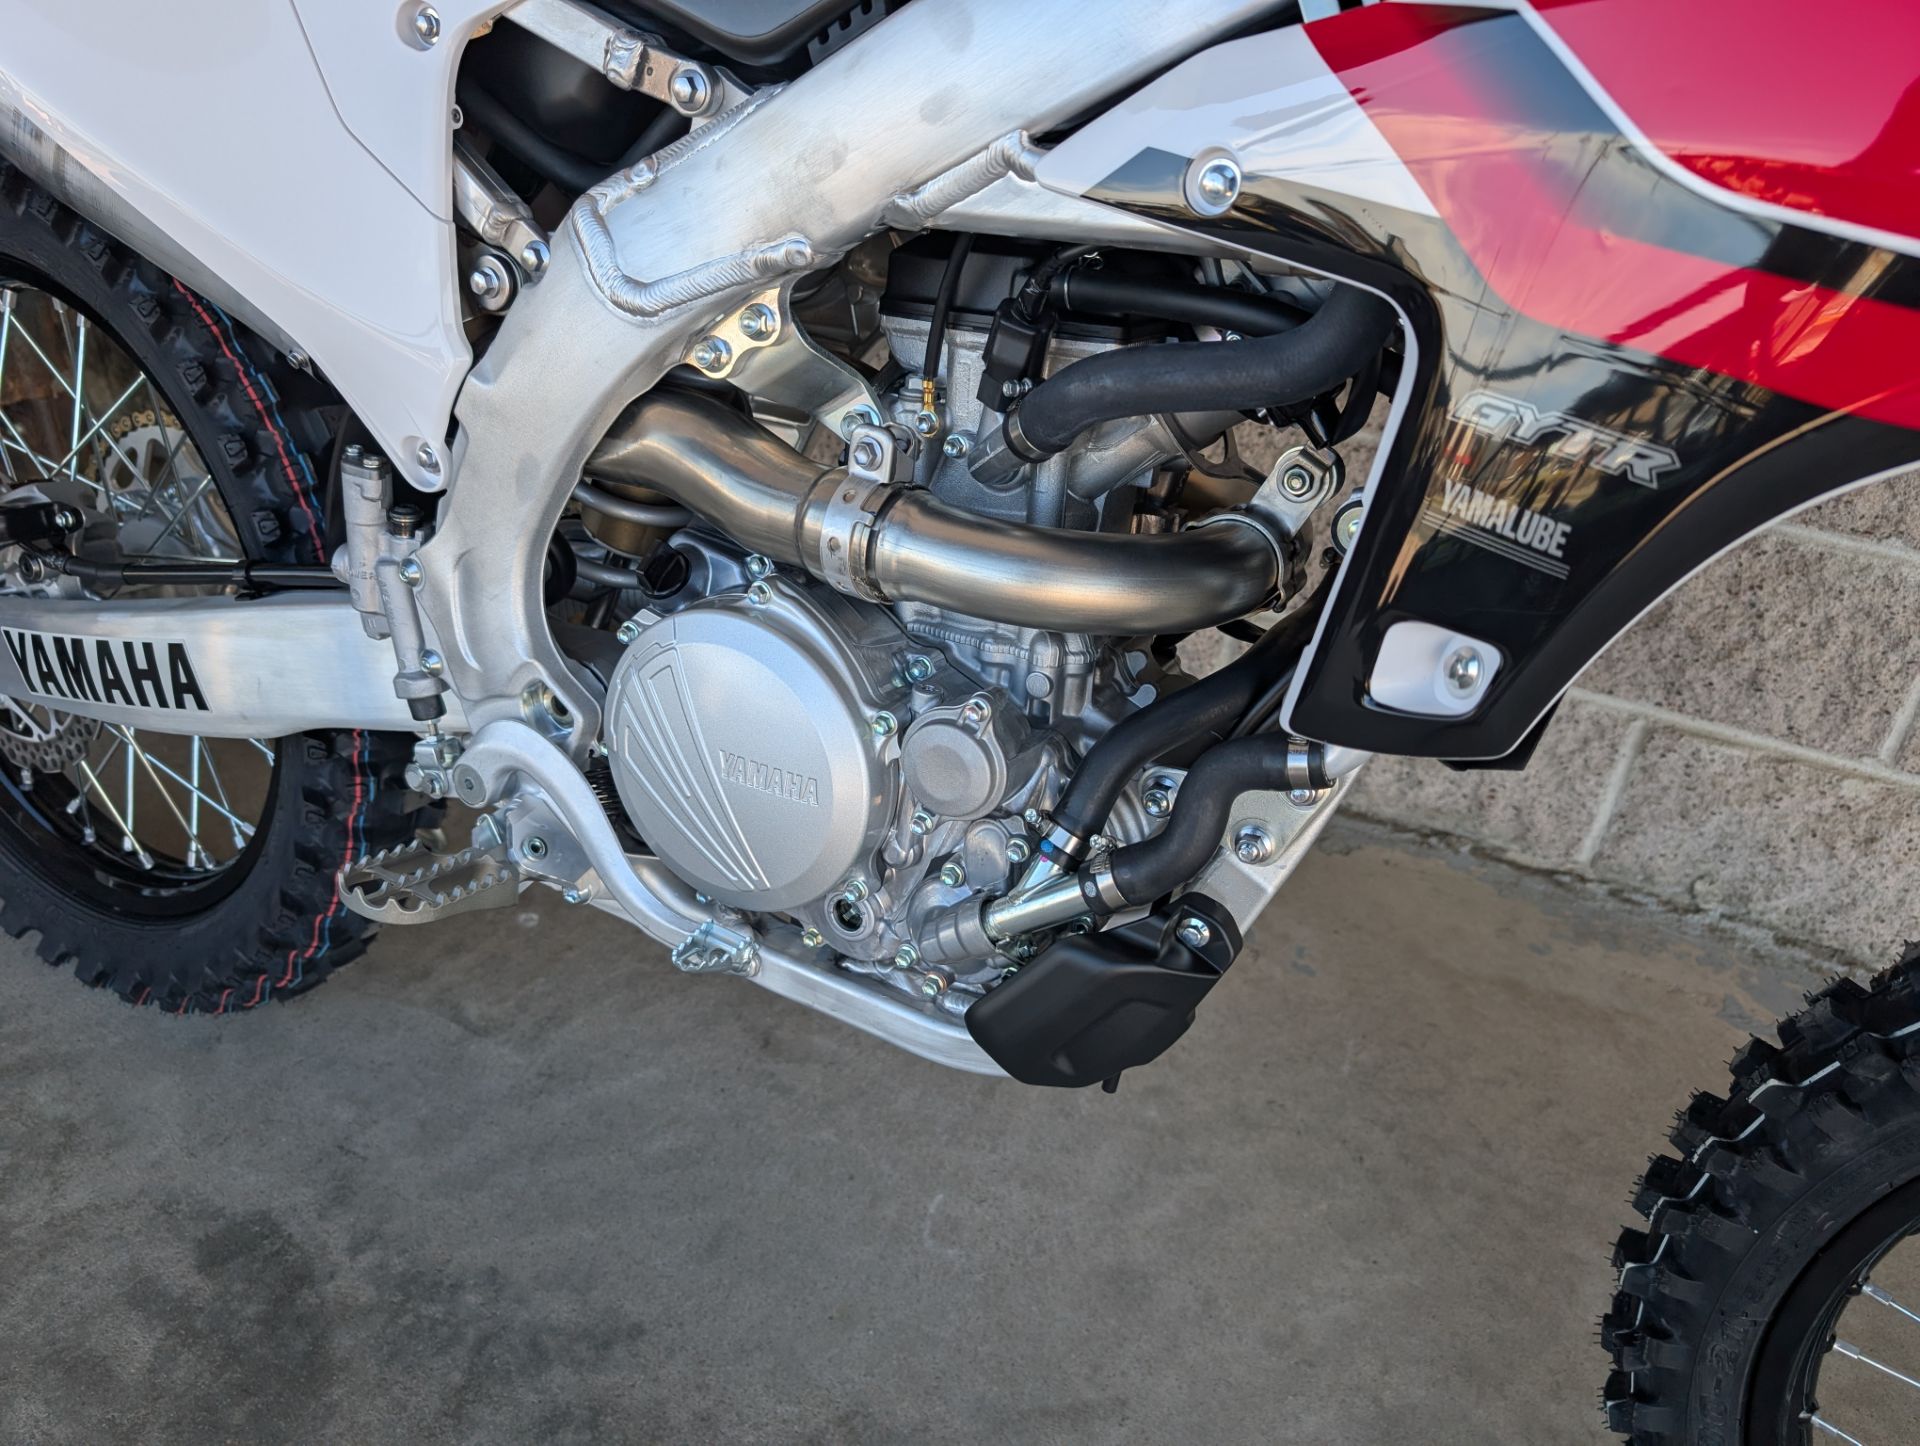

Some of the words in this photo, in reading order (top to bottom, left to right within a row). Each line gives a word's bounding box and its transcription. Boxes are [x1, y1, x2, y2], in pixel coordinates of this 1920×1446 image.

[1446, 390, 1682, 490] GYTR
[1443, 480, 1572, 558] YAMALUBE
[3, 629, 210, 711] YAMAHA
[719, 749, 819, 807] YAMAHA
